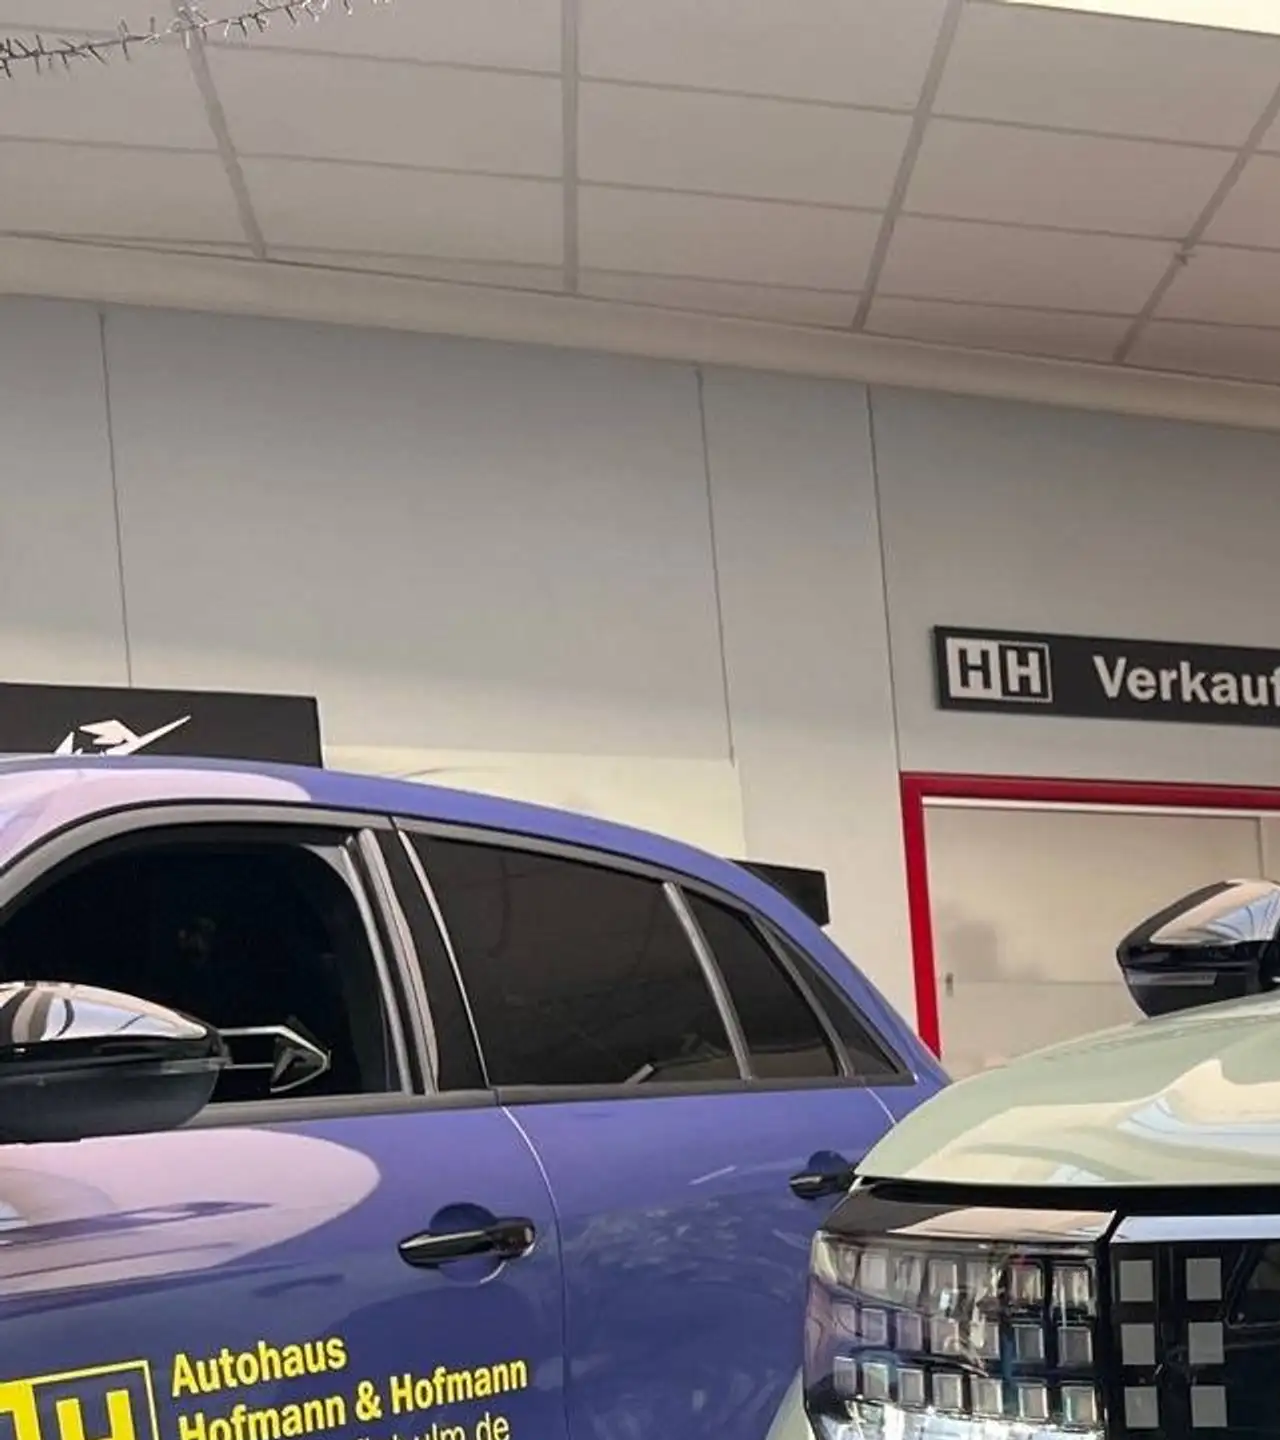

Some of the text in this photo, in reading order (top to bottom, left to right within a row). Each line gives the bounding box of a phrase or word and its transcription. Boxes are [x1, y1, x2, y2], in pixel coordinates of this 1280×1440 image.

[171, 1335, 349, 1398] Autohaus
[354, 1380, 383, 1423] &
[388, 1358, 528, 1414] Hofmann
